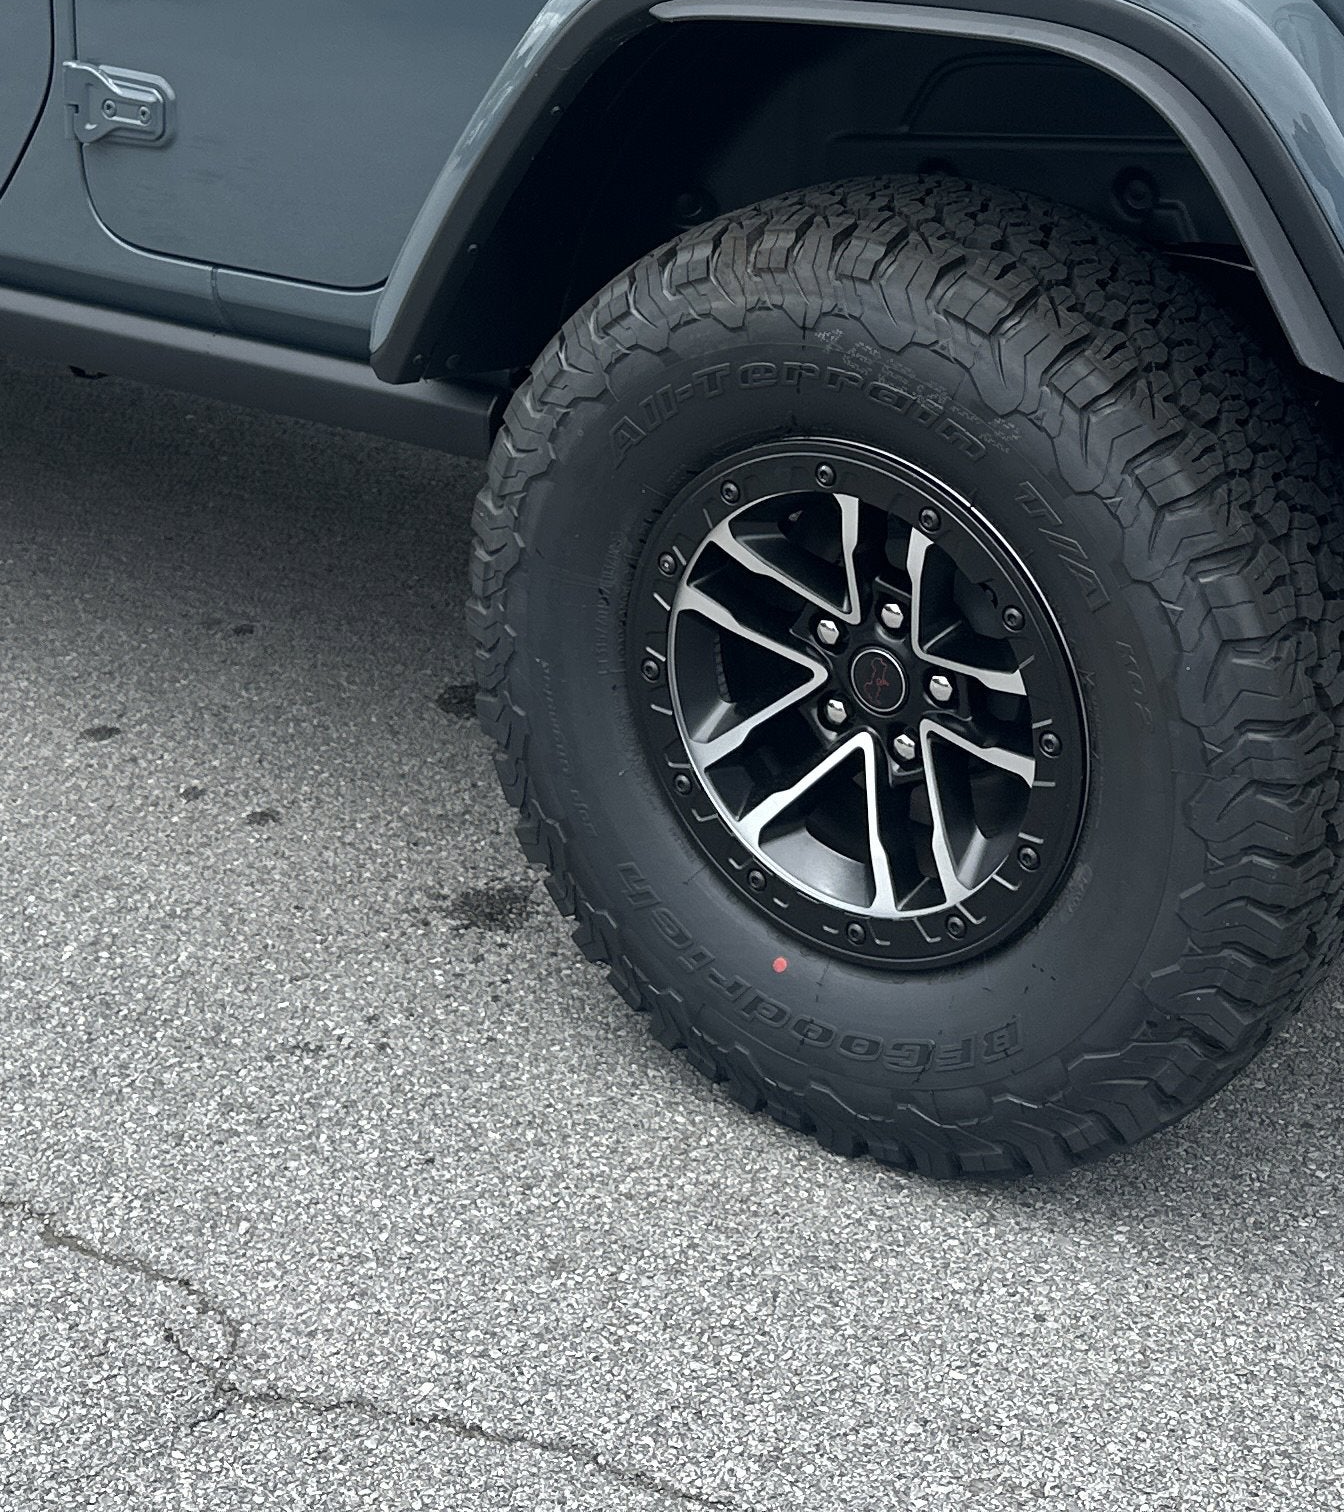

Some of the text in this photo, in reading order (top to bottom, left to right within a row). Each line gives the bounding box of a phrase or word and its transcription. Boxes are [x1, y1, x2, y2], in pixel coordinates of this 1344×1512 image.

[608, 360, 987, 470] All-Terrain
[1014, 480, 1112, 615] T/A
[615, 861, 1026, 1073] BFGoodrich
